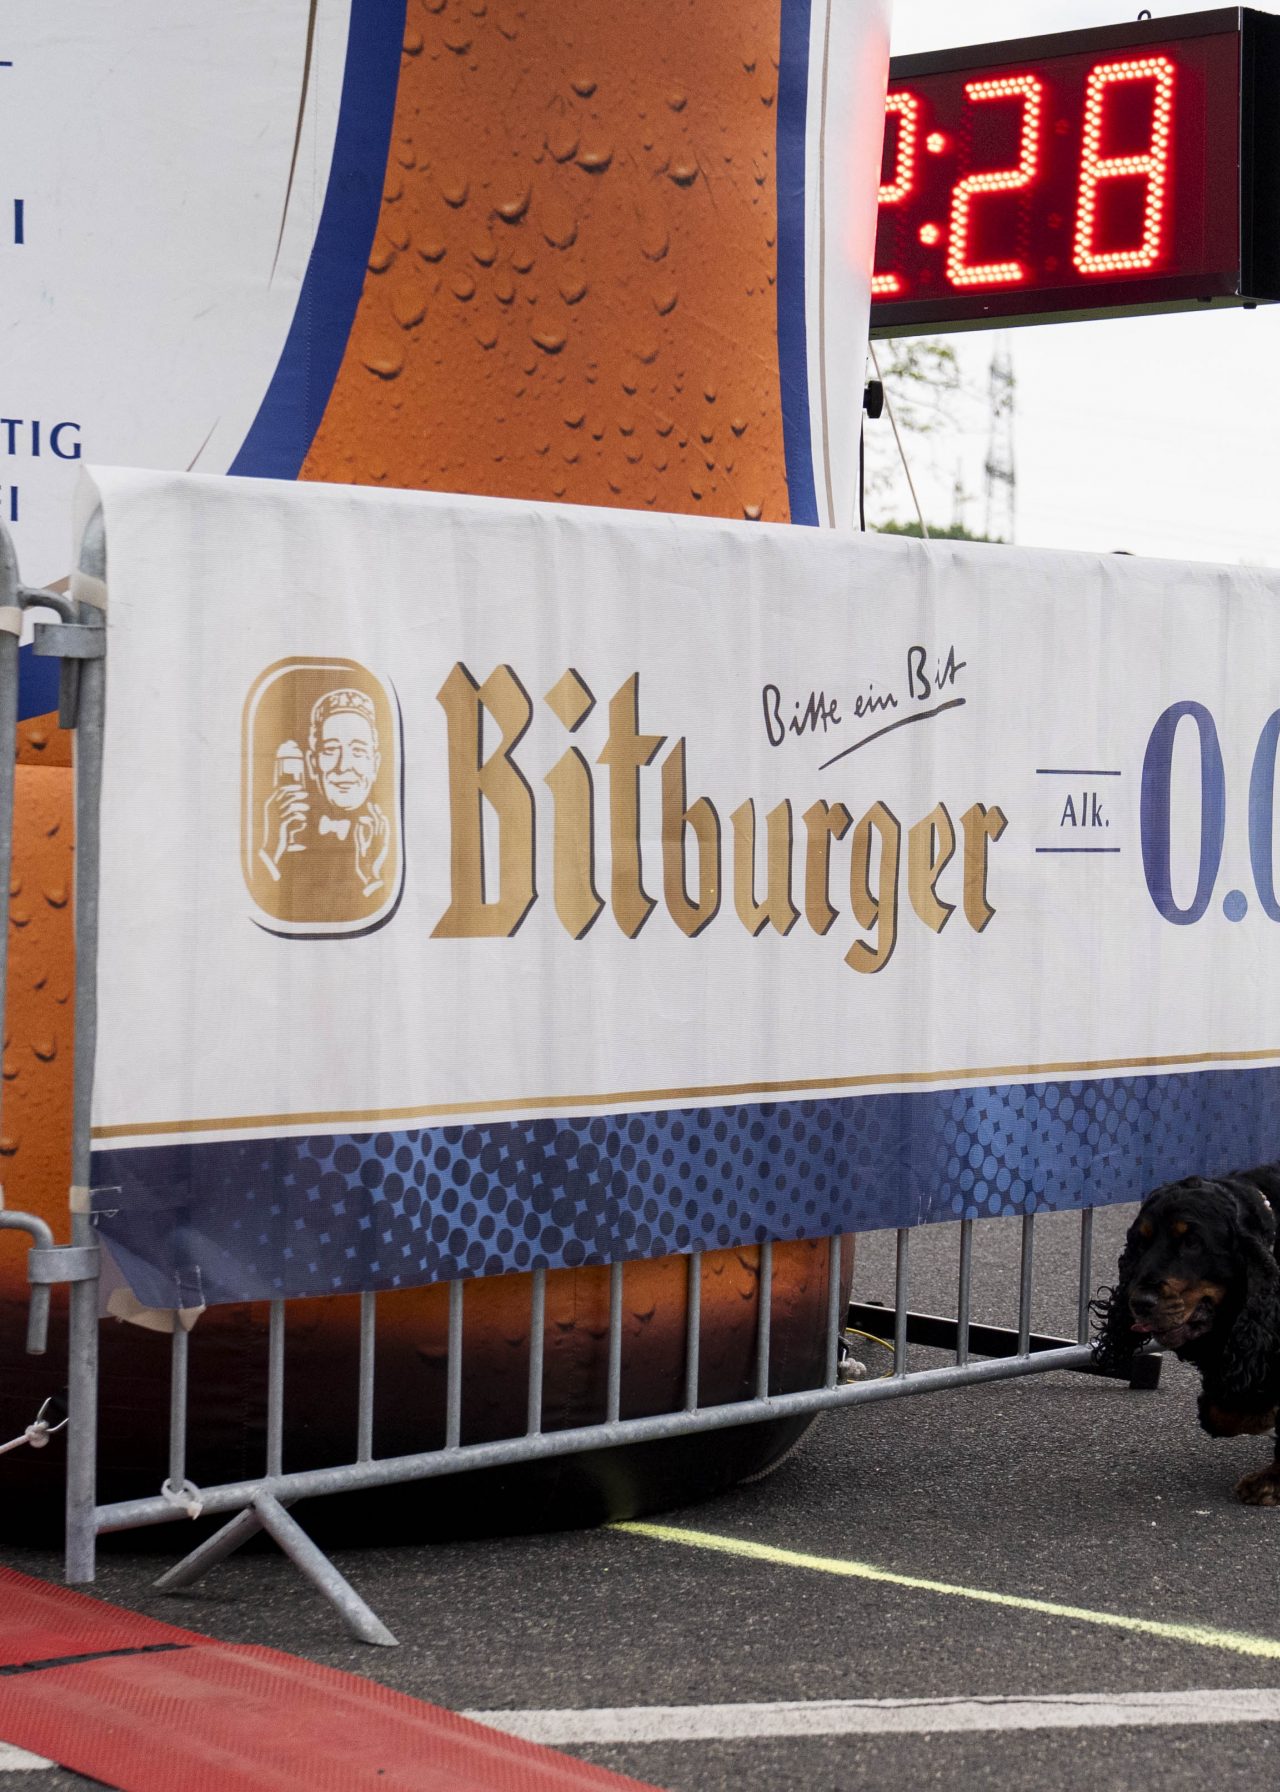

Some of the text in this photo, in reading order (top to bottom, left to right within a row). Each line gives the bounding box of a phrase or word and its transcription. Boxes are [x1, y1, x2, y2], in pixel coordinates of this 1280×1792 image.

[762, 645, 967, 746] Bitte ein Bit
[429, 661, 1009, 974] Bitburger
[1060, 792, 1110, 827] Alk.
